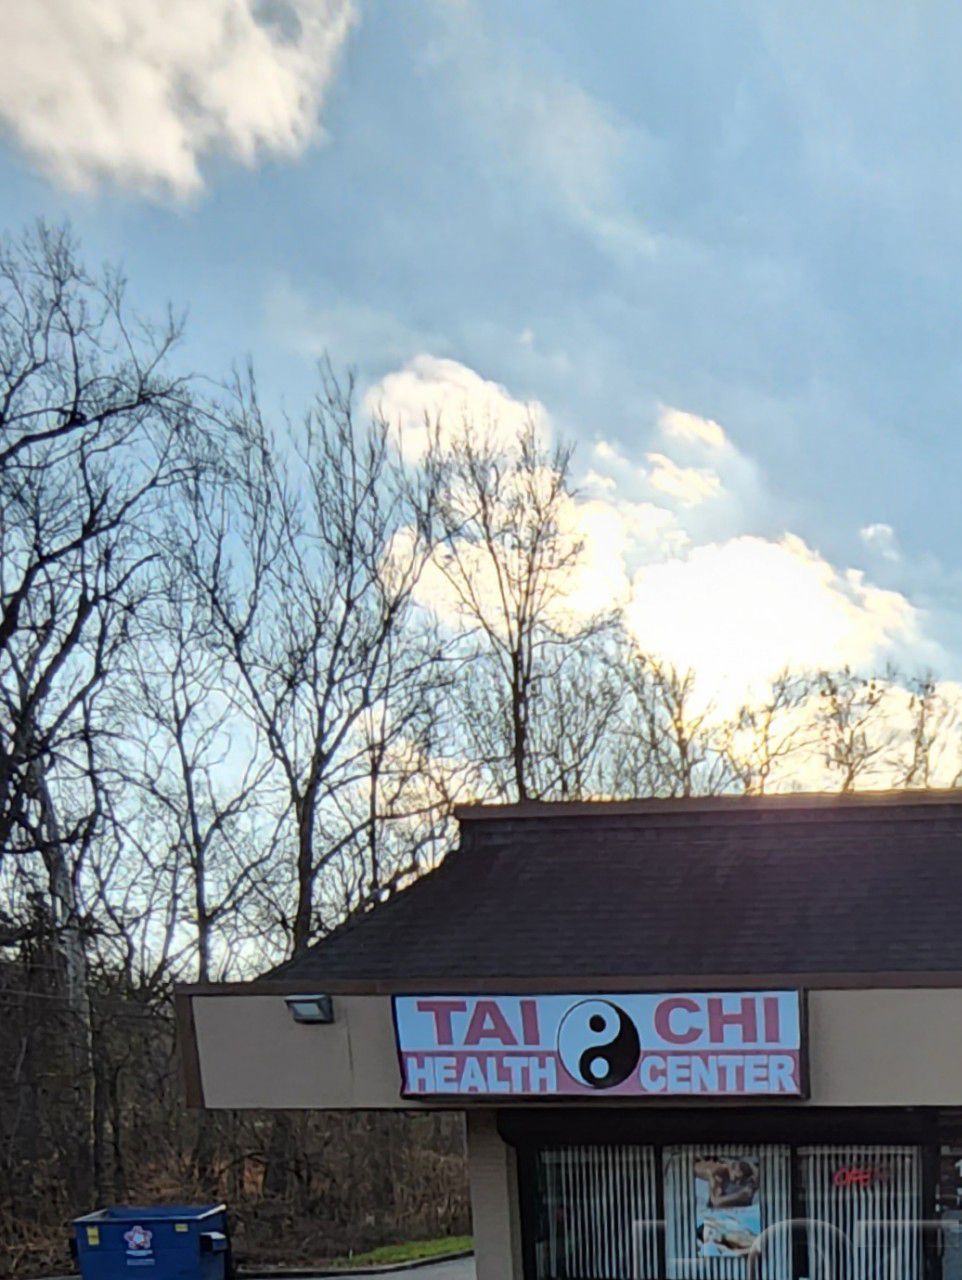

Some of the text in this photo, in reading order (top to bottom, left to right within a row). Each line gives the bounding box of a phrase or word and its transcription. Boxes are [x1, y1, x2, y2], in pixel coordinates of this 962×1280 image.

[416, 997, 780, 1046] TAI CHI
[406, 1054, 799, 1094] HEALTH CENTER
